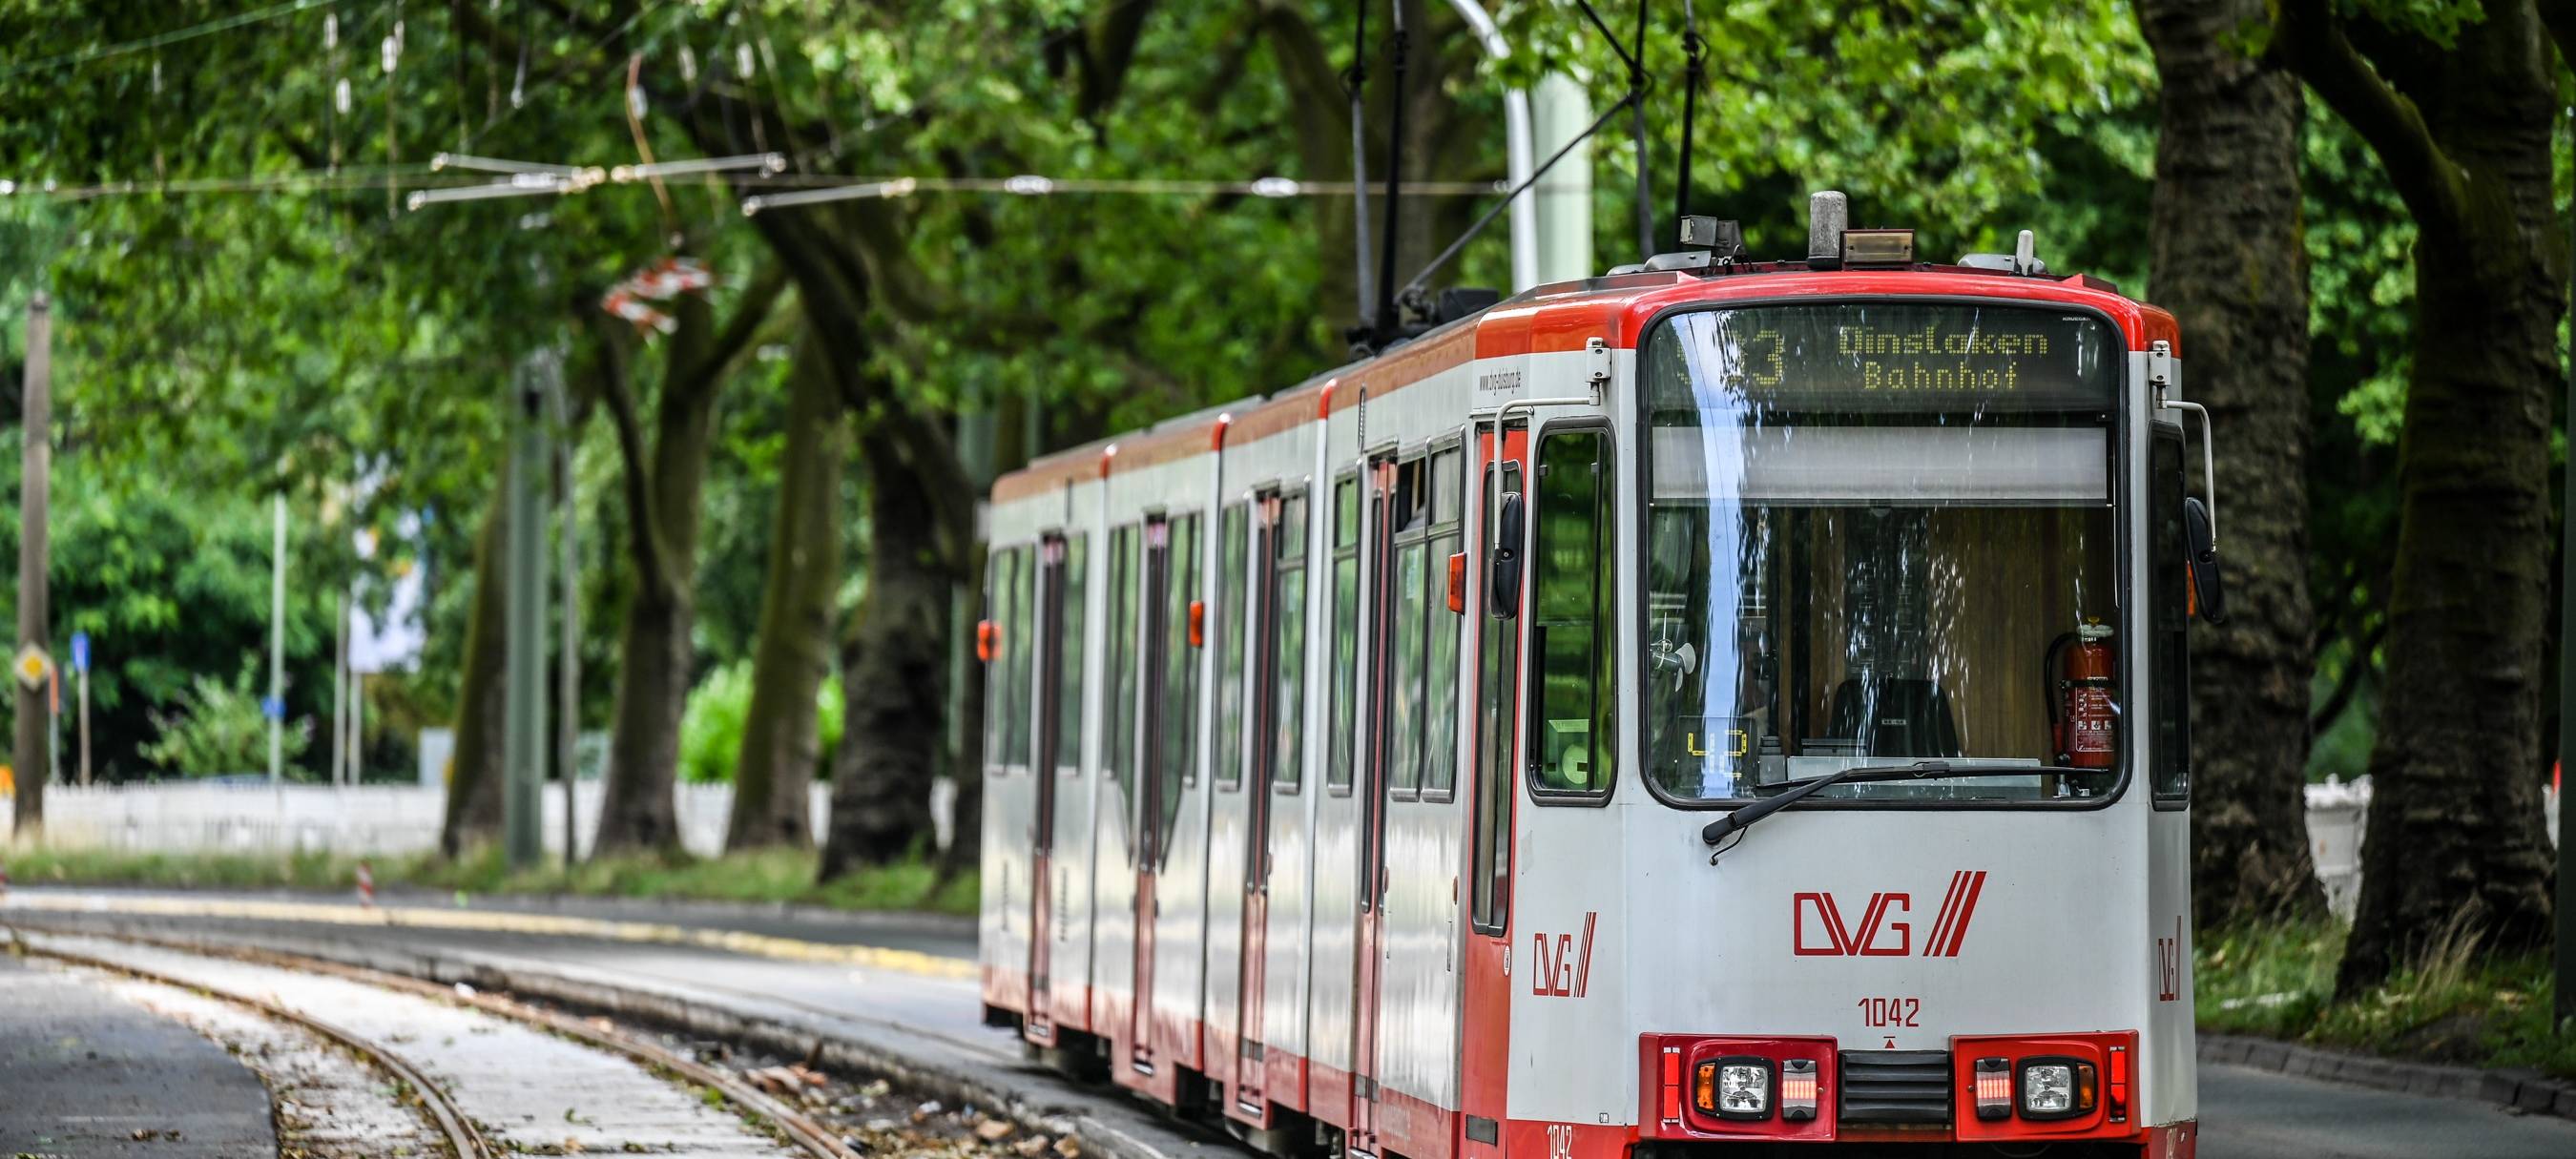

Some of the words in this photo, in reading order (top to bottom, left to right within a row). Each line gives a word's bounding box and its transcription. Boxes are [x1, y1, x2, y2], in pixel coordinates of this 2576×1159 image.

[1839, 326, 2048, 354] Dinslaken
[1865, 361, 2017, 389] Bahnhof
[1794, 893, 1910, 956] DVG
[1533, 933, 1571, 998] DVG
[1858, 998, 1920, 1027] 1042
[1547, 1124, 1572, 1159] 1042
